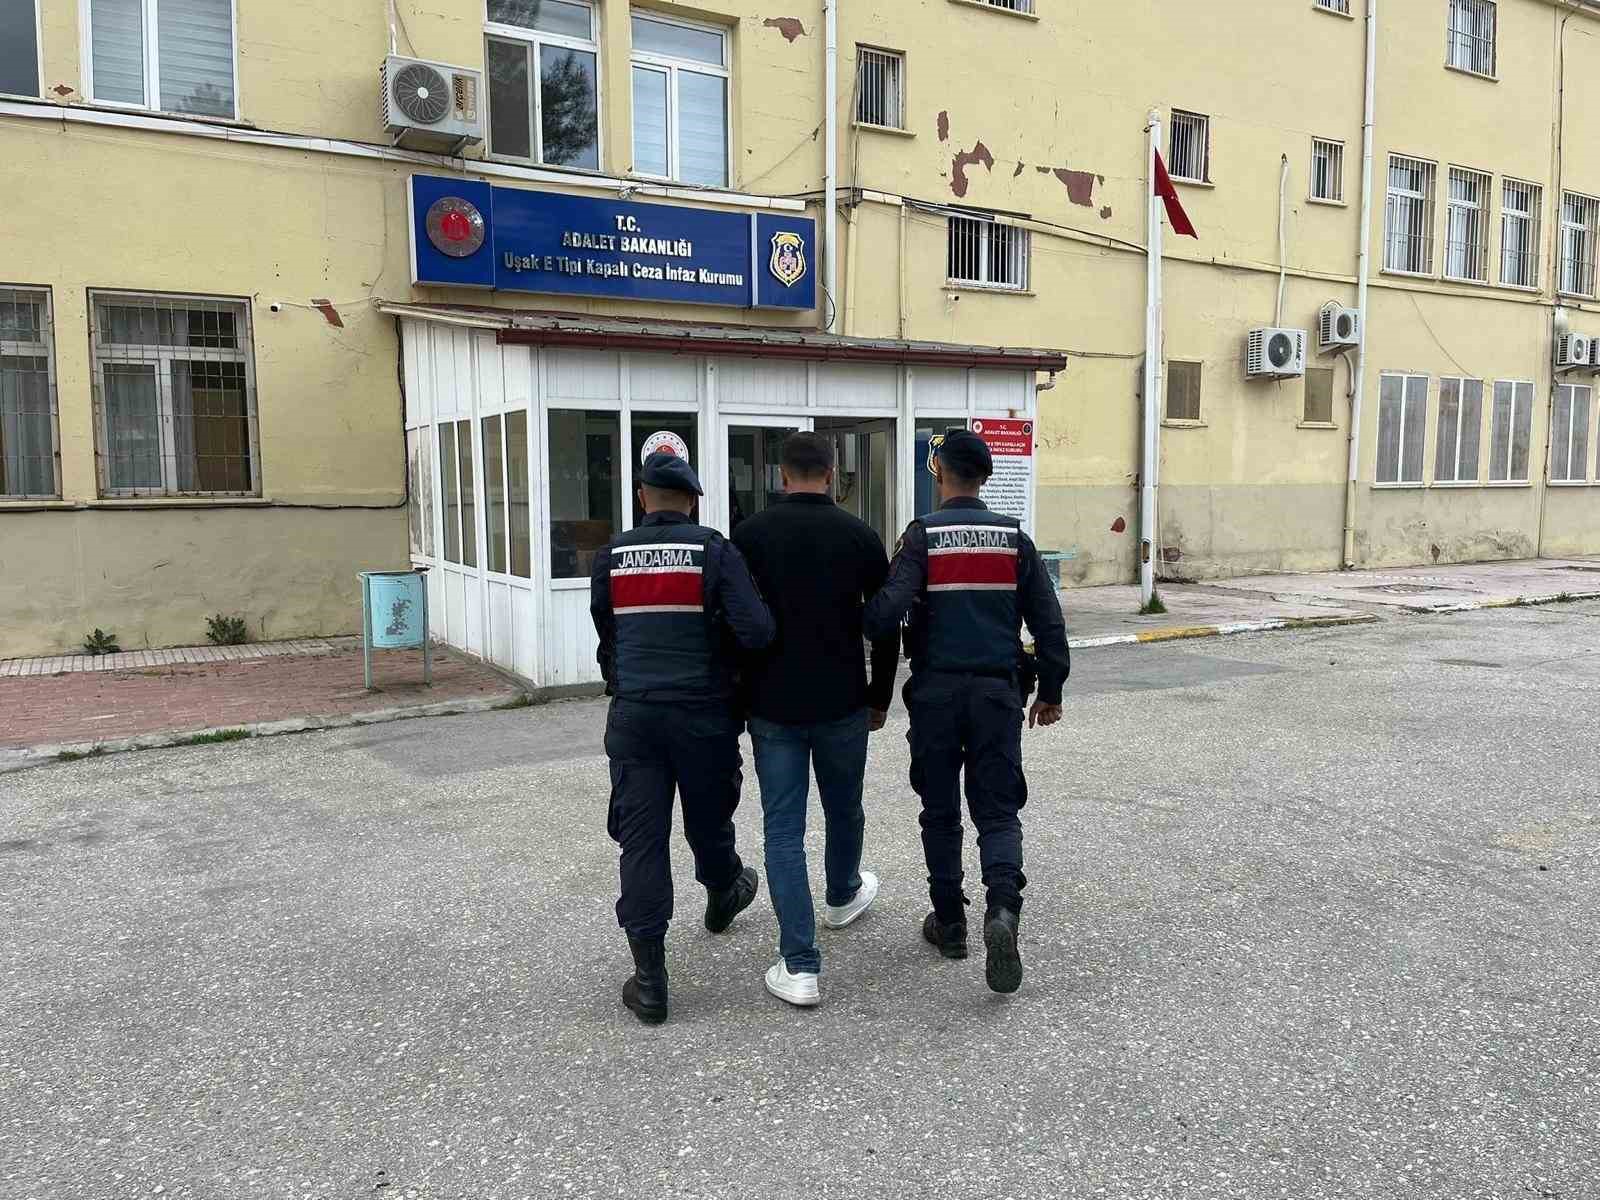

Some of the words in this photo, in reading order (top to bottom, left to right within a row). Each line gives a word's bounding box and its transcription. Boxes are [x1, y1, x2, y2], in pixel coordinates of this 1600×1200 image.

[616, 215, 641, 232] T.C.
[562, 231, 616, 250] ADALET
[620, 236, 692, 257] BAKANLIĞI
[504, 251, 540, 273] Uşak
[544, 255, 553, 271] E
[556, 256, 582, 276] Tipi
[586, 259, 629, 279] Kapalı
[632, 262, 663, 280] Ceza
[665, 262, 696, 282] İnfaz
[699, 268, 744, 286] Kurumu
[935, 531, 1009, 549] JANDARMA
[618, 550, 693, 569] JANDARMA
